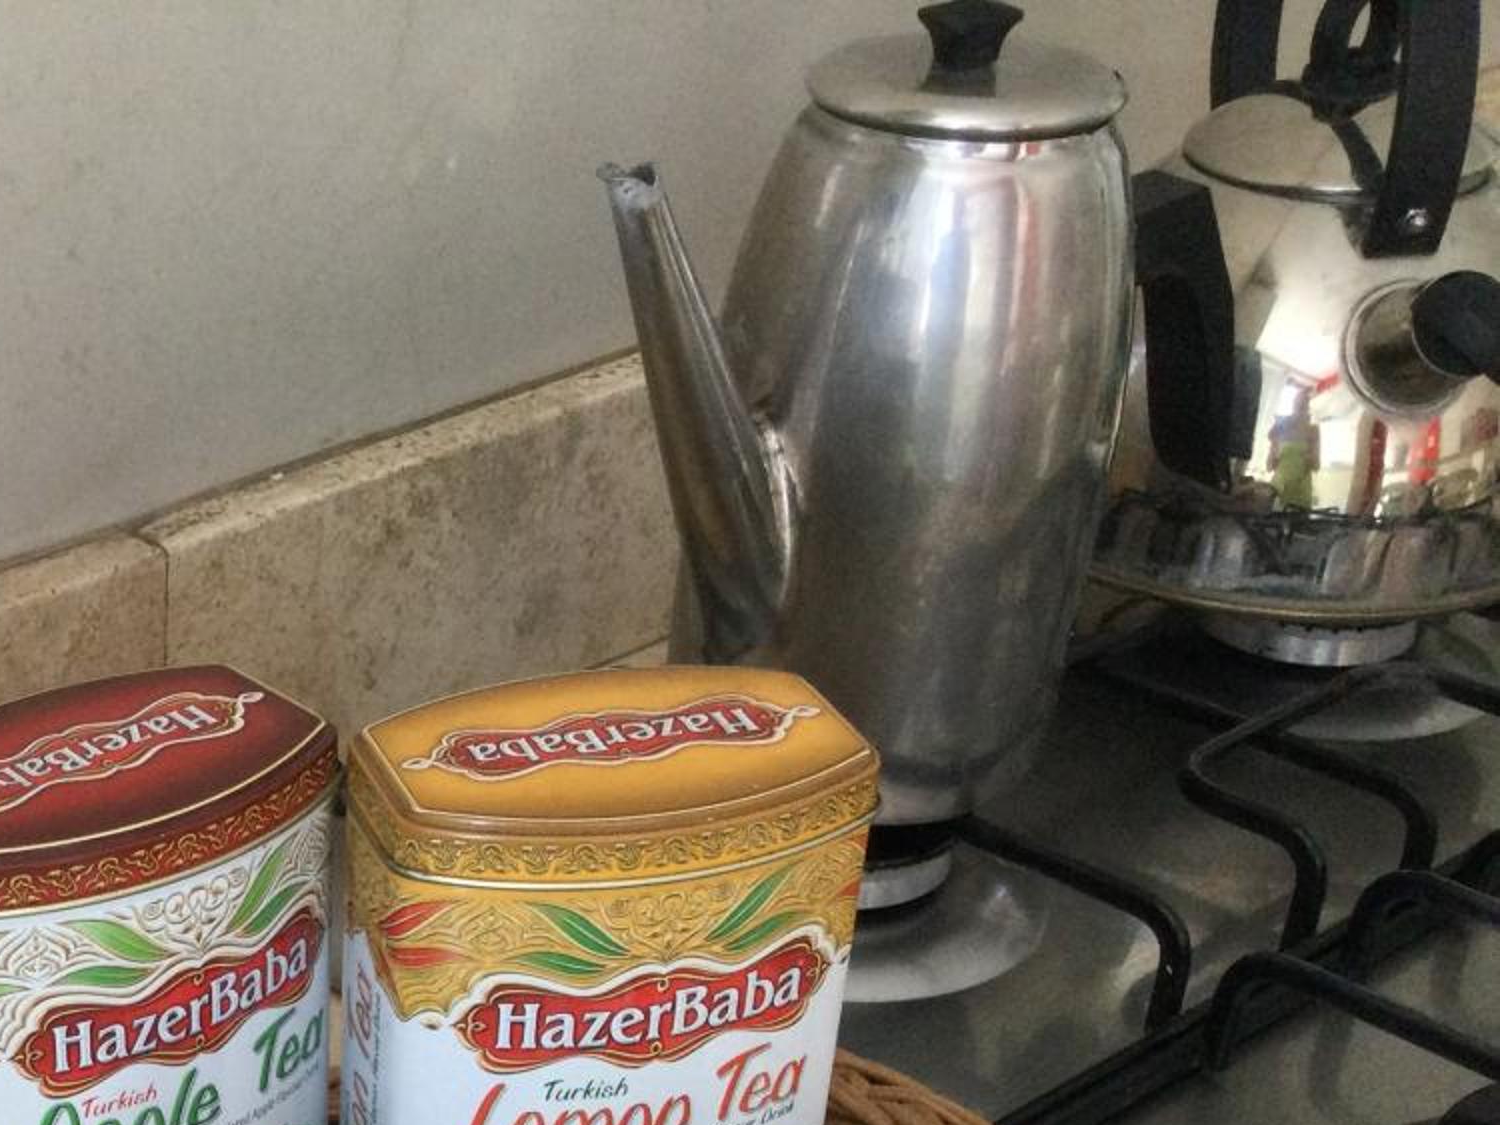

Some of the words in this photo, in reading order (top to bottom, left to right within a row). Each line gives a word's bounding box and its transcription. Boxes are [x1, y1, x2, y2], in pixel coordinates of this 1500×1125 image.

[467, 707, 760, 762] HazerBaba
[53, 938, 310, 1074] HazerBaba
[496, 964, 802, 1050] HazerBaba
[252, 1007, 324, 1092] Tea
[543, 1076, 630, 1102] Turkish
[716, 1042, 808, 1121] Tea
[81, 1084, 158, 1119] Turkish
